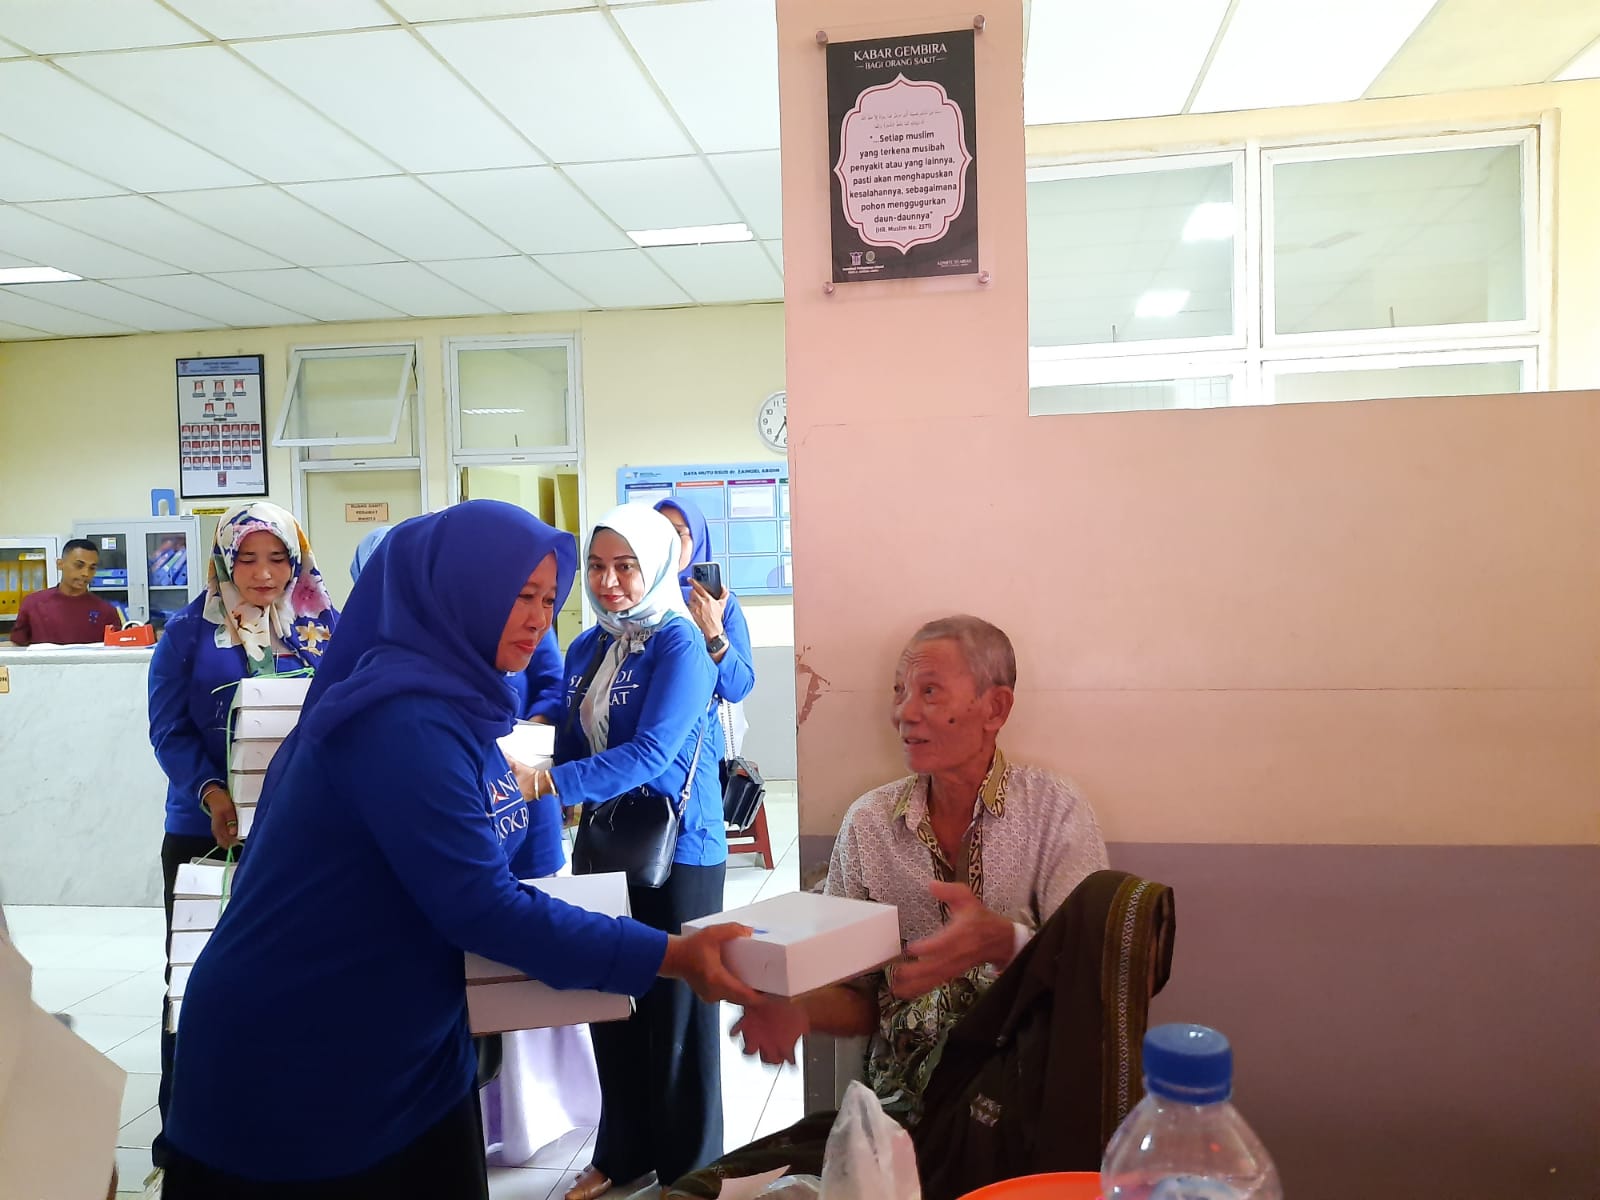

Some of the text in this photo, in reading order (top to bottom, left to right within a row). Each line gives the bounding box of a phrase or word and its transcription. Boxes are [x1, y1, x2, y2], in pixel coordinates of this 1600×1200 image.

[854, 43, 947, 62] KABAR GEMBIRA
[865, 56, 936, 70] BAGI ORANG SAKIT
[905, 130, 935, 140] muslim
[859, 142, 945, 159] yang terkena musibah
[850, 161, 883, 174] penyakit
[885, 160, 903, 169] atau
[904, 159, 923, 169] yang
[853, 170, 953, 185] pasti akan menghapuskan
[905, 183, 957, 195] sebagaimana
[860, 197, 946, 212] pohon menggugurkan
